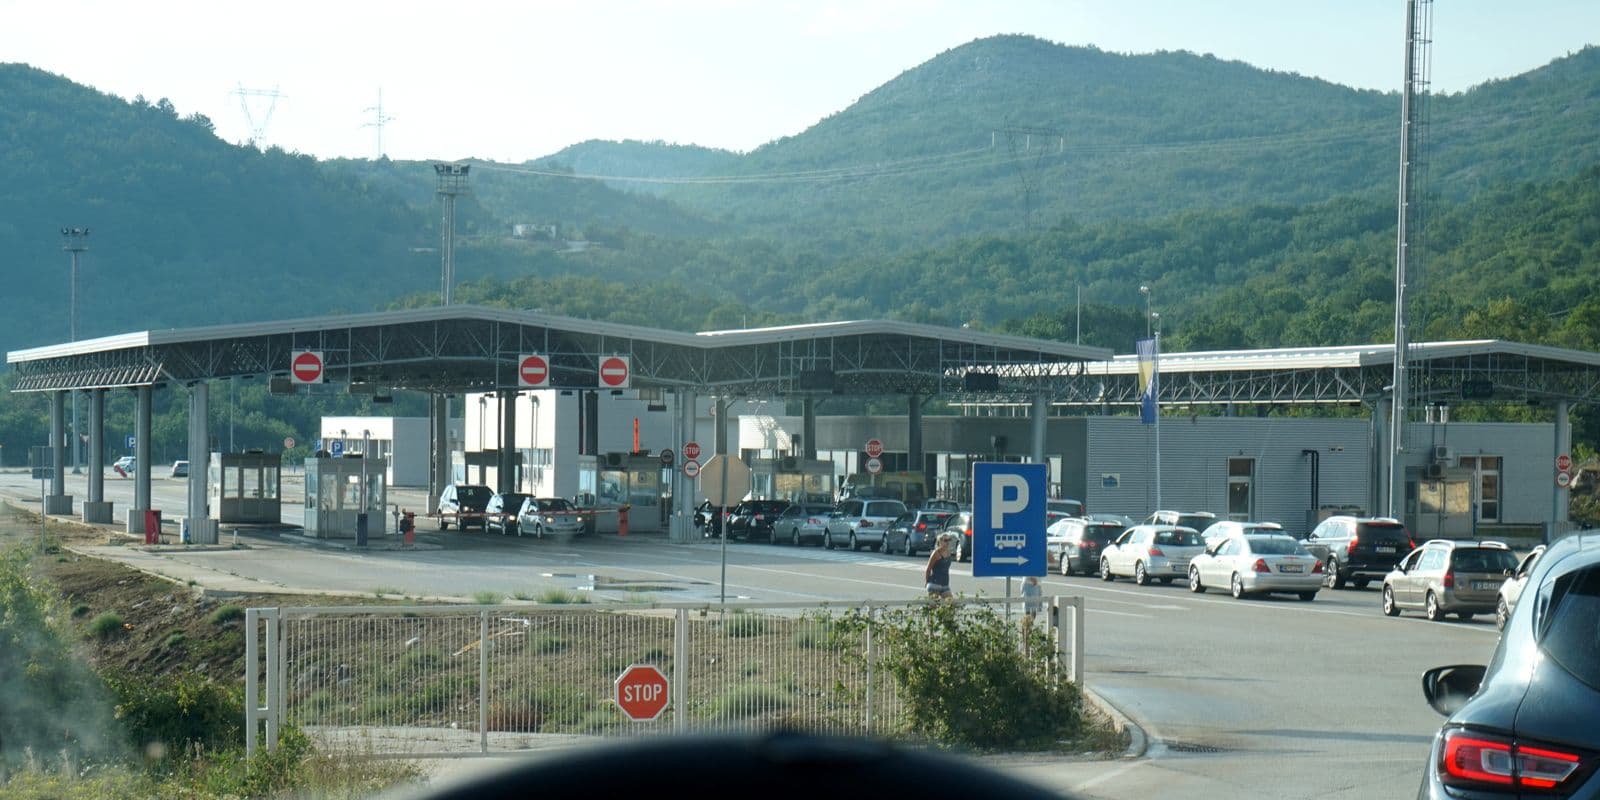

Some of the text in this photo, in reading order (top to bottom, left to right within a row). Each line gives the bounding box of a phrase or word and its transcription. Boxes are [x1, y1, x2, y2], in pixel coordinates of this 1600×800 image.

[334, 442, 341, 451] P
[685, 446, 701, 455] STOP
[868, 444, 881, 452] STOP
[991, 473, 1030, 529] P
[624, 683, 662, 702] STOP
